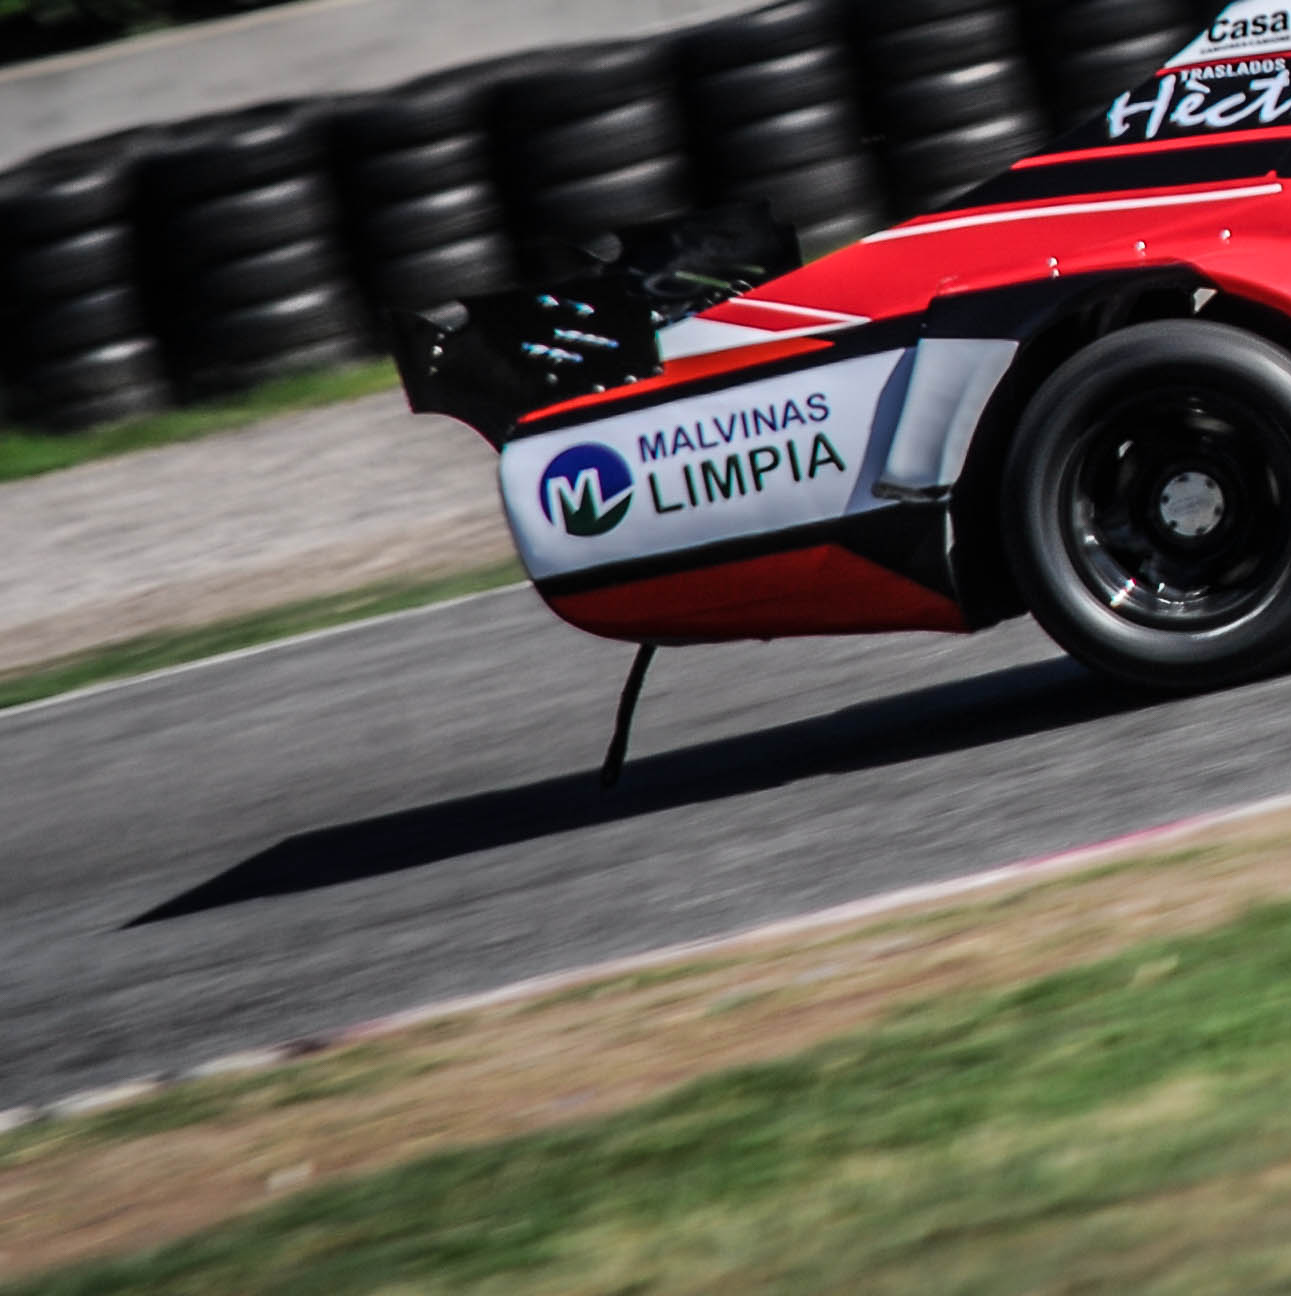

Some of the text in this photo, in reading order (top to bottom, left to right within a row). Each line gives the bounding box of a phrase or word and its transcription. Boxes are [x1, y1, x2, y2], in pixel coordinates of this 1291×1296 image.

[1207, 9, 1289, 43] Casa
[1179, 58, 1286, 81] TRASLADOS
[638, 393, 831, 462] MALVINAS
[648, 432, 846, 514] LIMPIA
